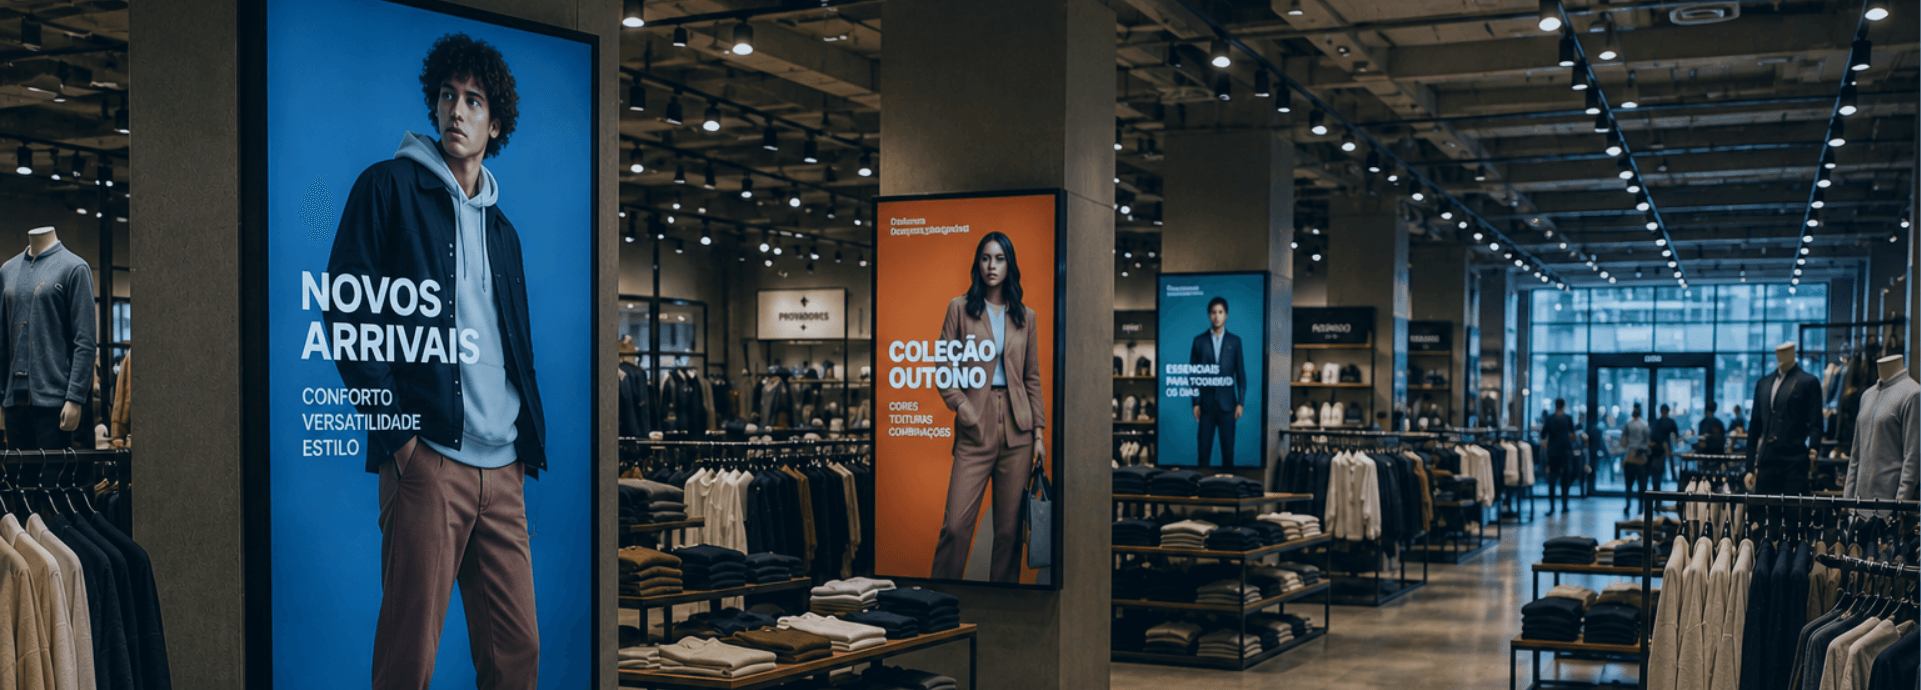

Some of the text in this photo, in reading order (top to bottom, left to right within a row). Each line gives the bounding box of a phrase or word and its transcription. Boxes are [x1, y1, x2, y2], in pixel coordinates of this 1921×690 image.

[302, 271, 442, 318] NOVOS
[301, 321, 480, 364] ARRIVAIS
[888, 334, 996, 367] COLEÇÃO
[888, 366, 987, 390] OUTONO
[302, 387, 393, 406] CONFORTO
[888, 401, 919, 412] CORES
[302, 413, 421, 431] VERSATILIDADE
[302, 438, 359, 457] ESTILO
